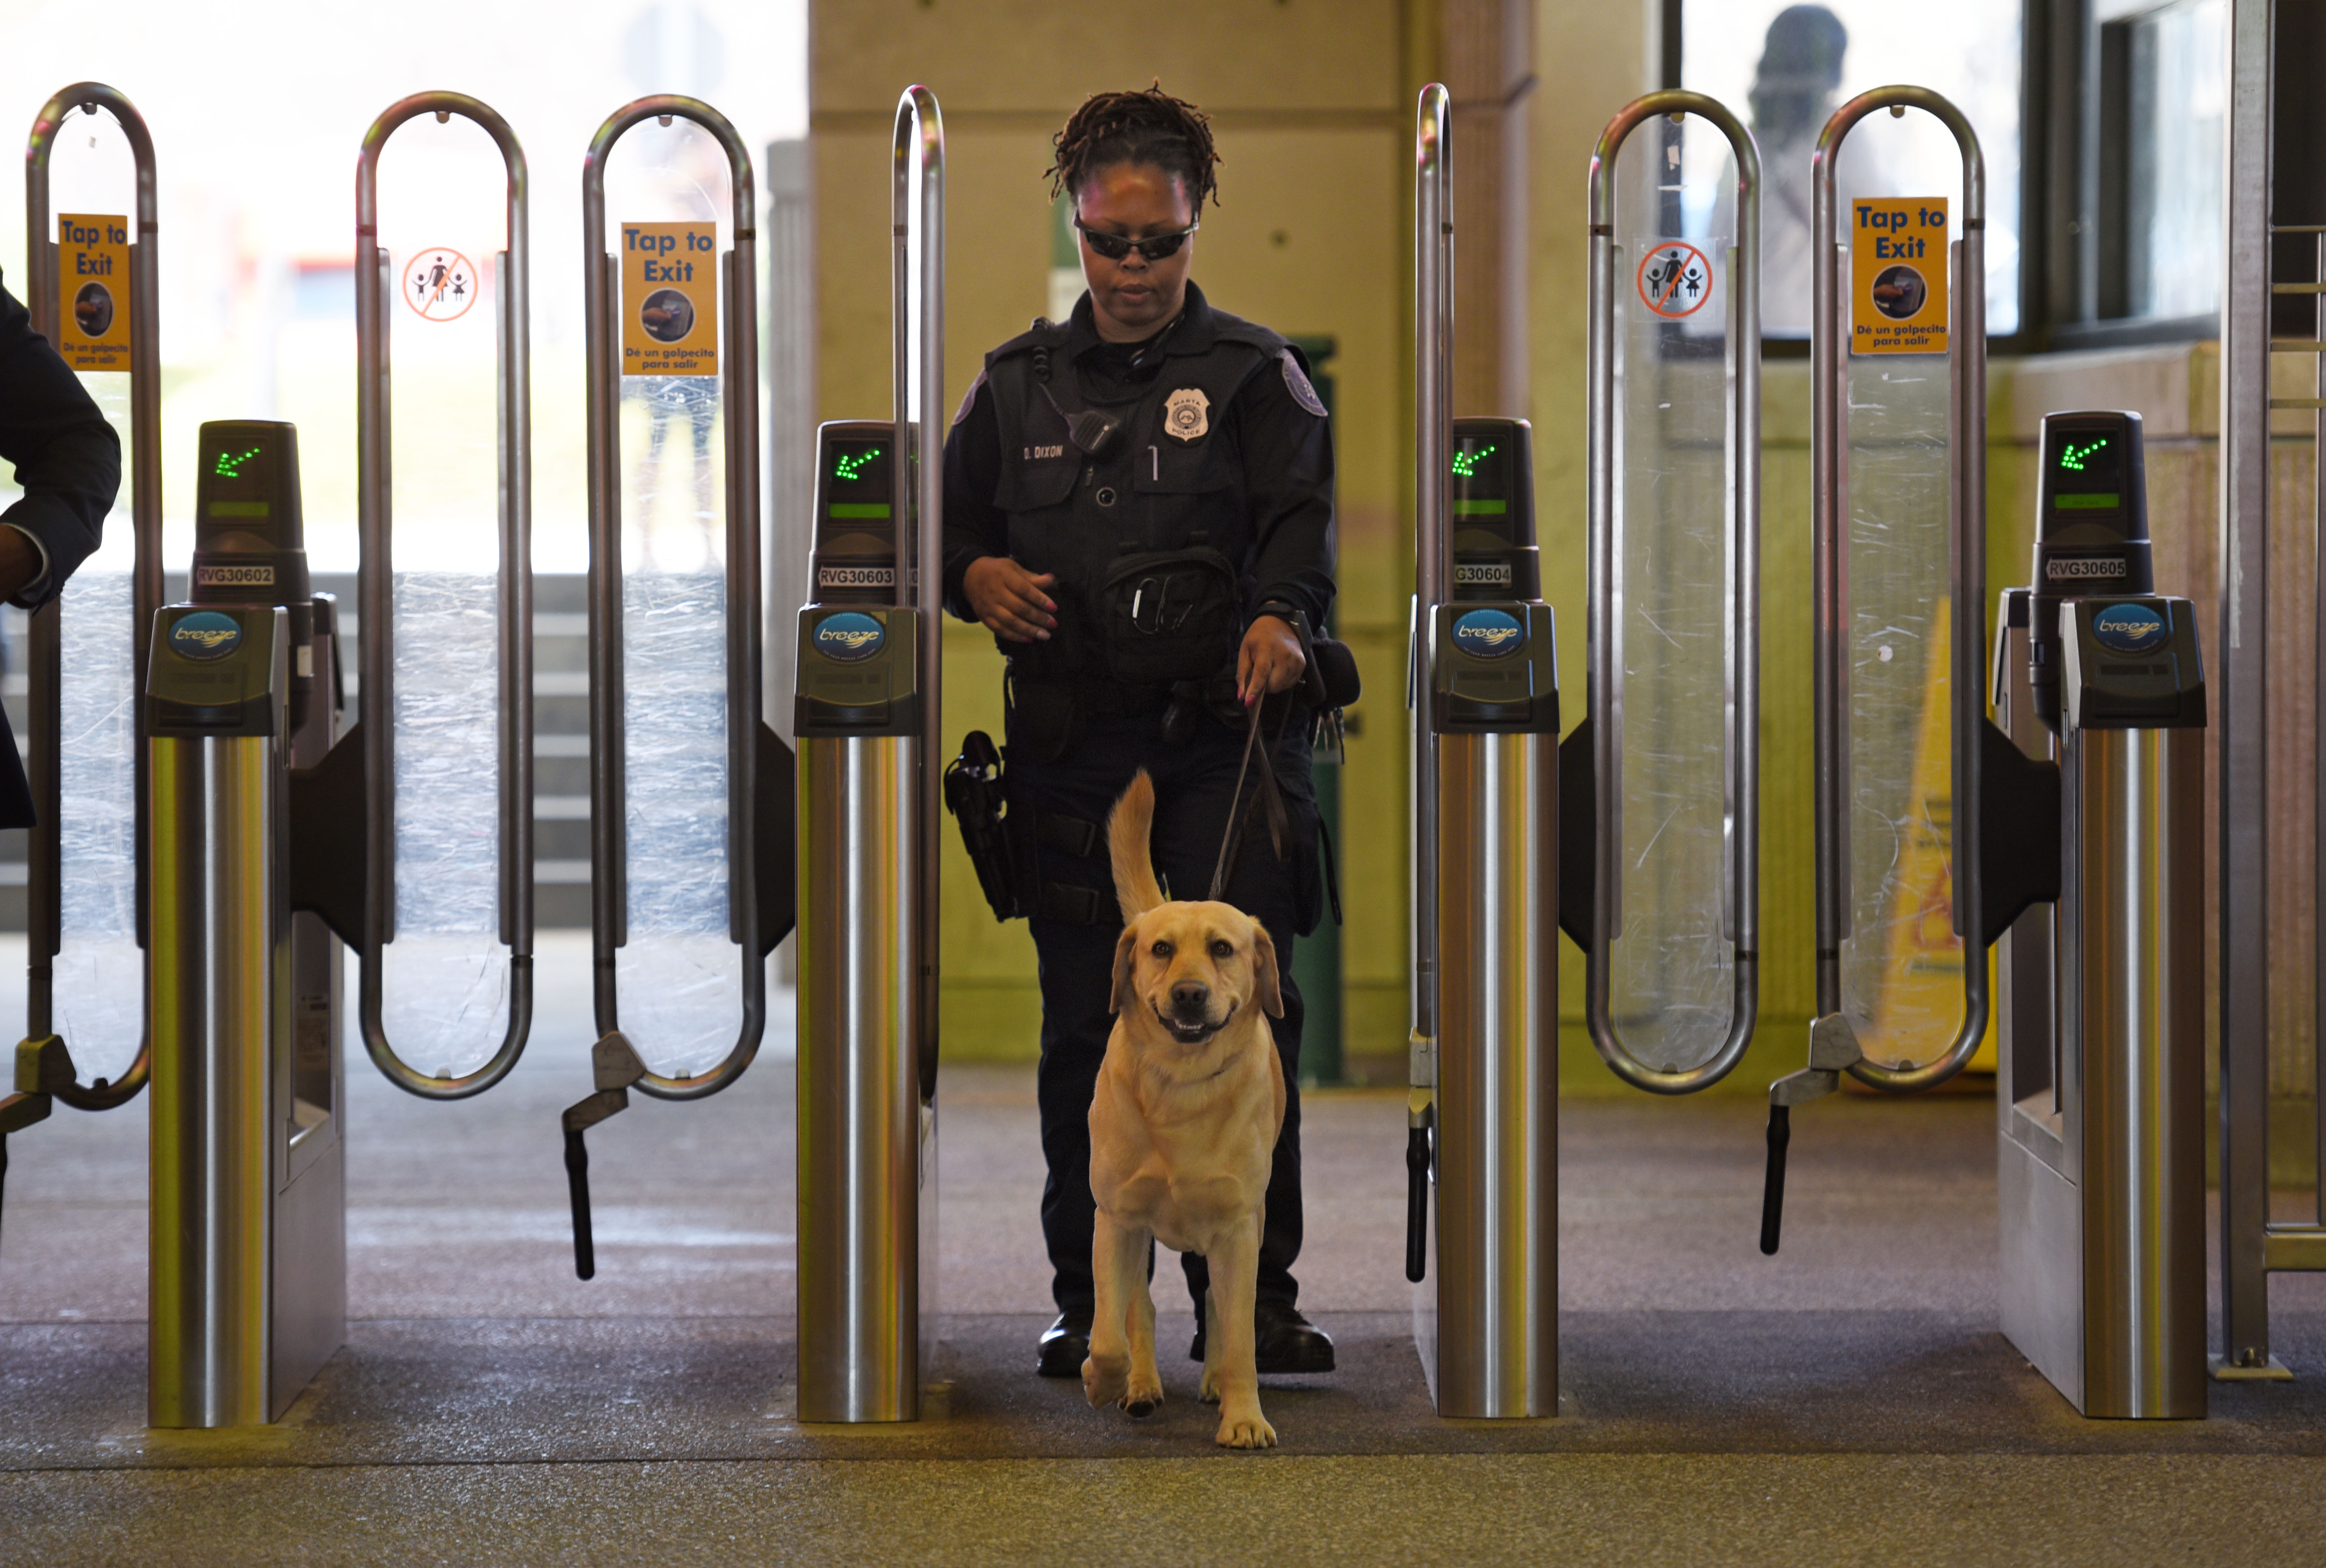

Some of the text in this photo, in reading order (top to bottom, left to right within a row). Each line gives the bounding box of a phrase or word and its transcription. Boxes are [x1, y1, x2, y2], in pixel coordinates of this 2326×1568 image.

[1857, 207, 1945, 233] Tap to
[62, 221, 125, 249] Tap to
[625, 229, 713, 257] Tap to
[1876, 236, 1925, 258] Exit
[77, 253, 112, 275] Exit
[644, 260, 693, 282] Exit
[1894, 324, 1946, 336] golpecito
[1874, 336, 1930, 347] para salir
[76, 354, 117, 365] para salir
[663, 348, 715, 359] golpecito
[643, 359, 699, 370] para salir
[1035, 445, 1063, 458] DIXON
[1456, 567, 1510, 581] G30604
[2050, 562, 2125, 575] RVG30605
[199, 569, 271, 582] RVG30602
[821, 570, 892, 583] RVG30603
[1458, 625, 1518, 637] breeze
[2100, 620, 2160, 631] breeze
[175, 628, 237, 640] breeze
[820, 628, 879, 641] breeze
